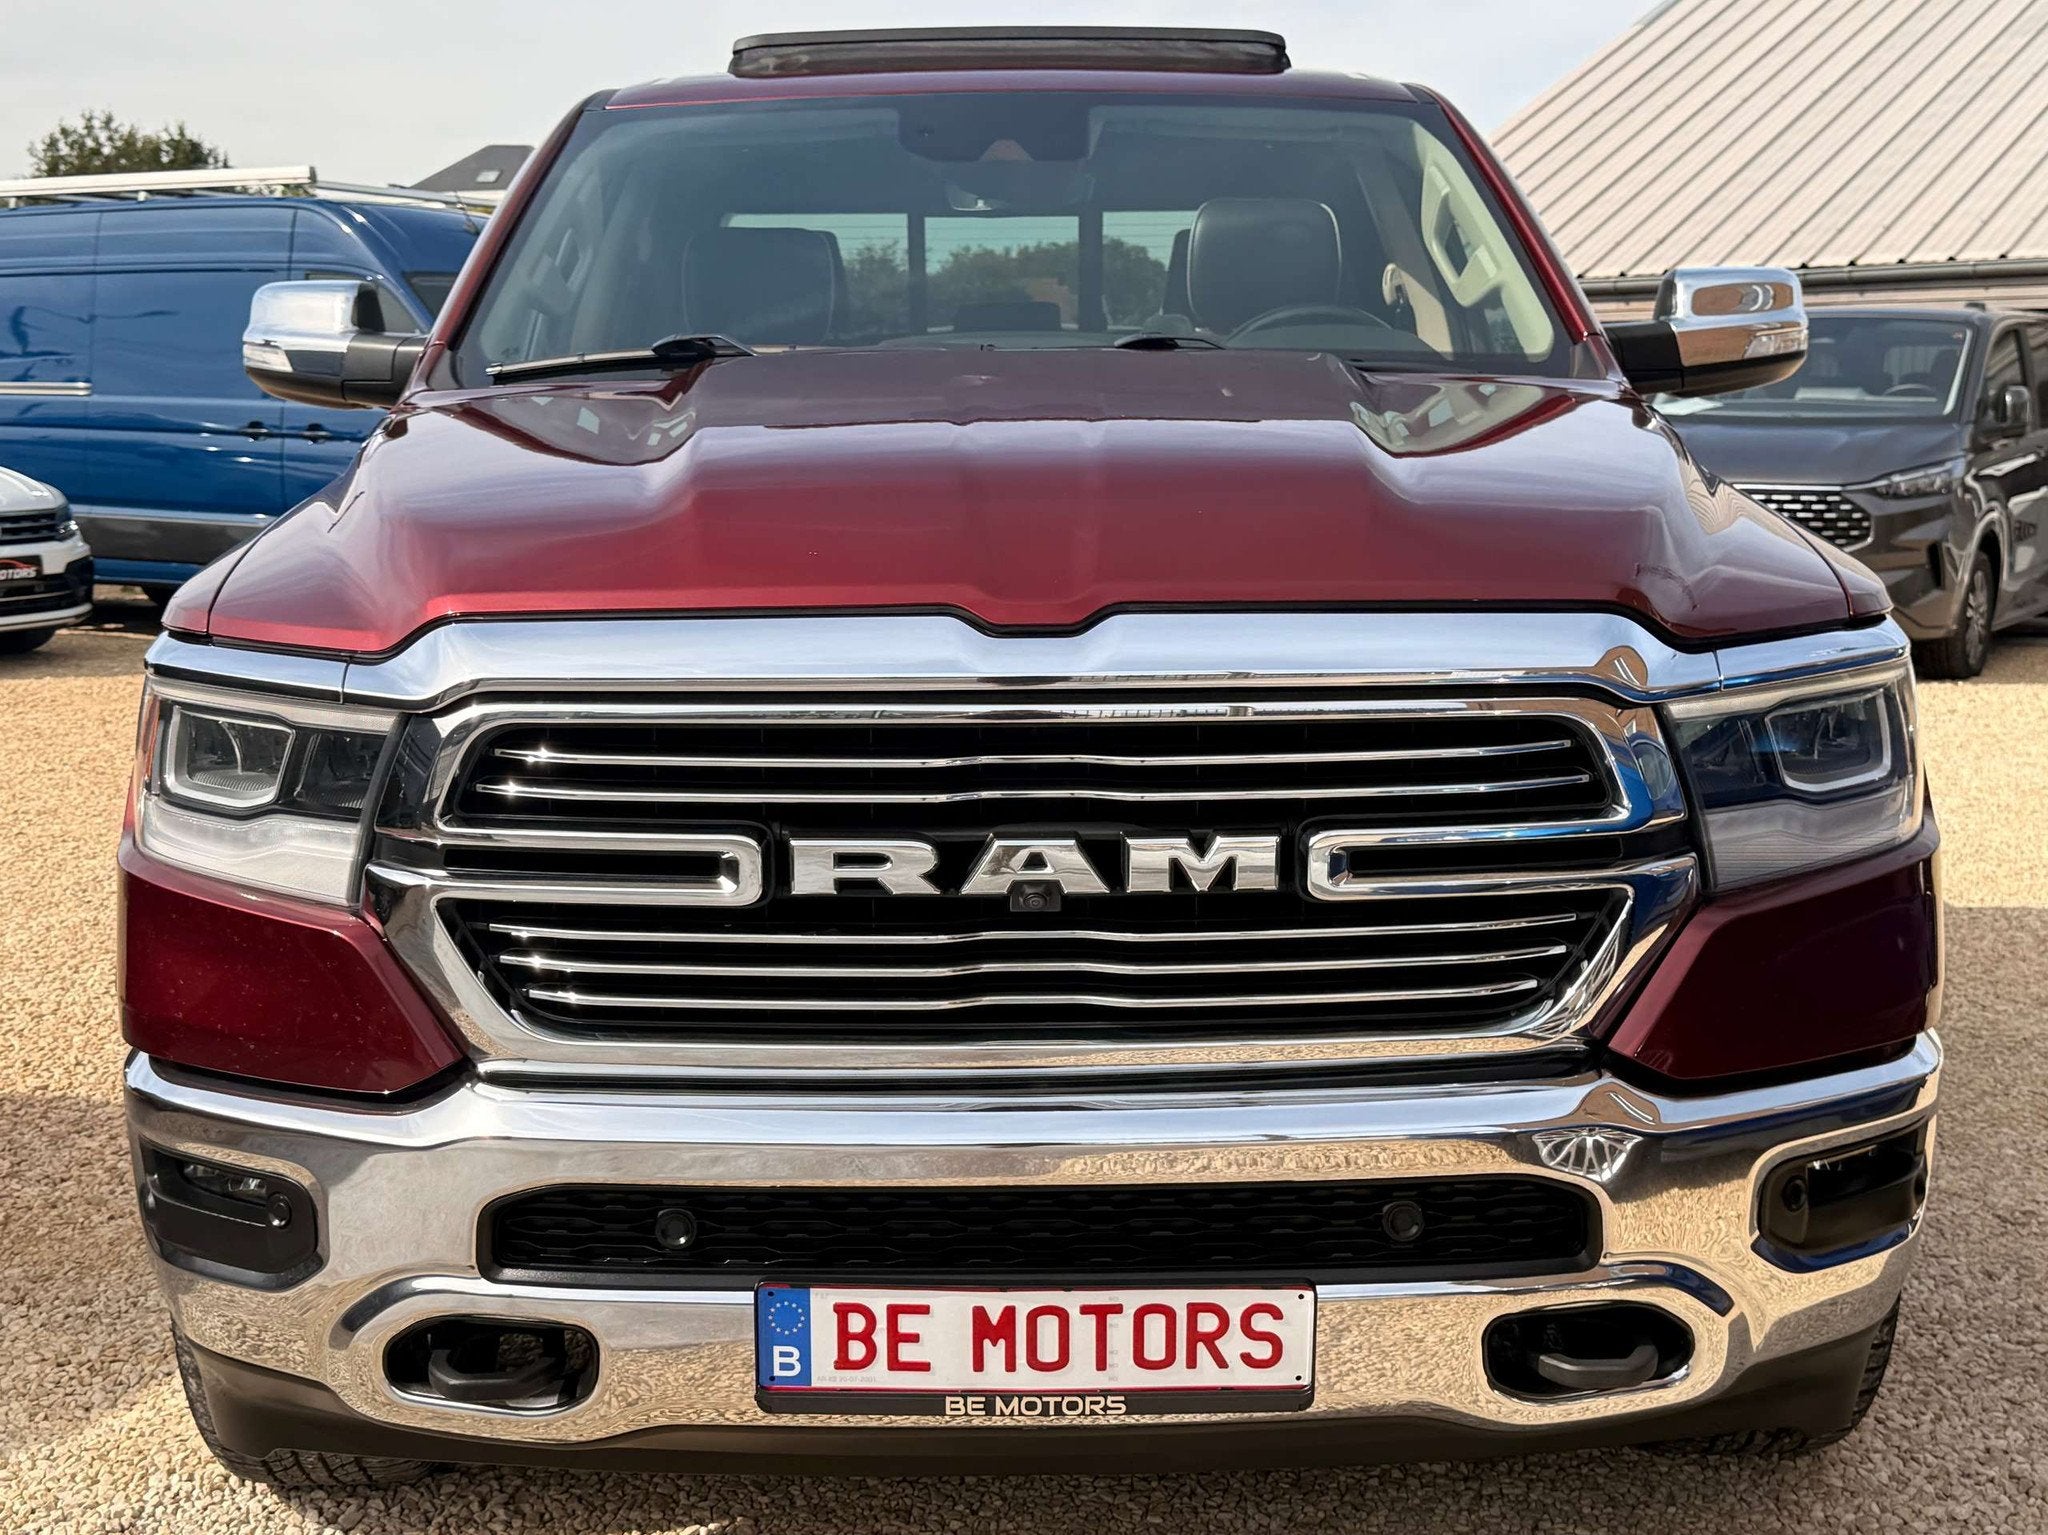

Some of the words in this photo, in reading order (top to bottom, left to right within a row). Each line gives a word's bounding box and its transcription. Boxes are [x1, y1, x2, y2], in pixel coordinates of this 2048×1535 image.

[789, 836, 1281, 895] RAM
[833, 1302, 931, 1373] BE
[972, 1302, 1284, 1373] MOTORS
[772, 1345, 801, 1378] B
[945, 1395, 986, 1416] BE
[995, 1395, 1127, 1416] MOTORS
